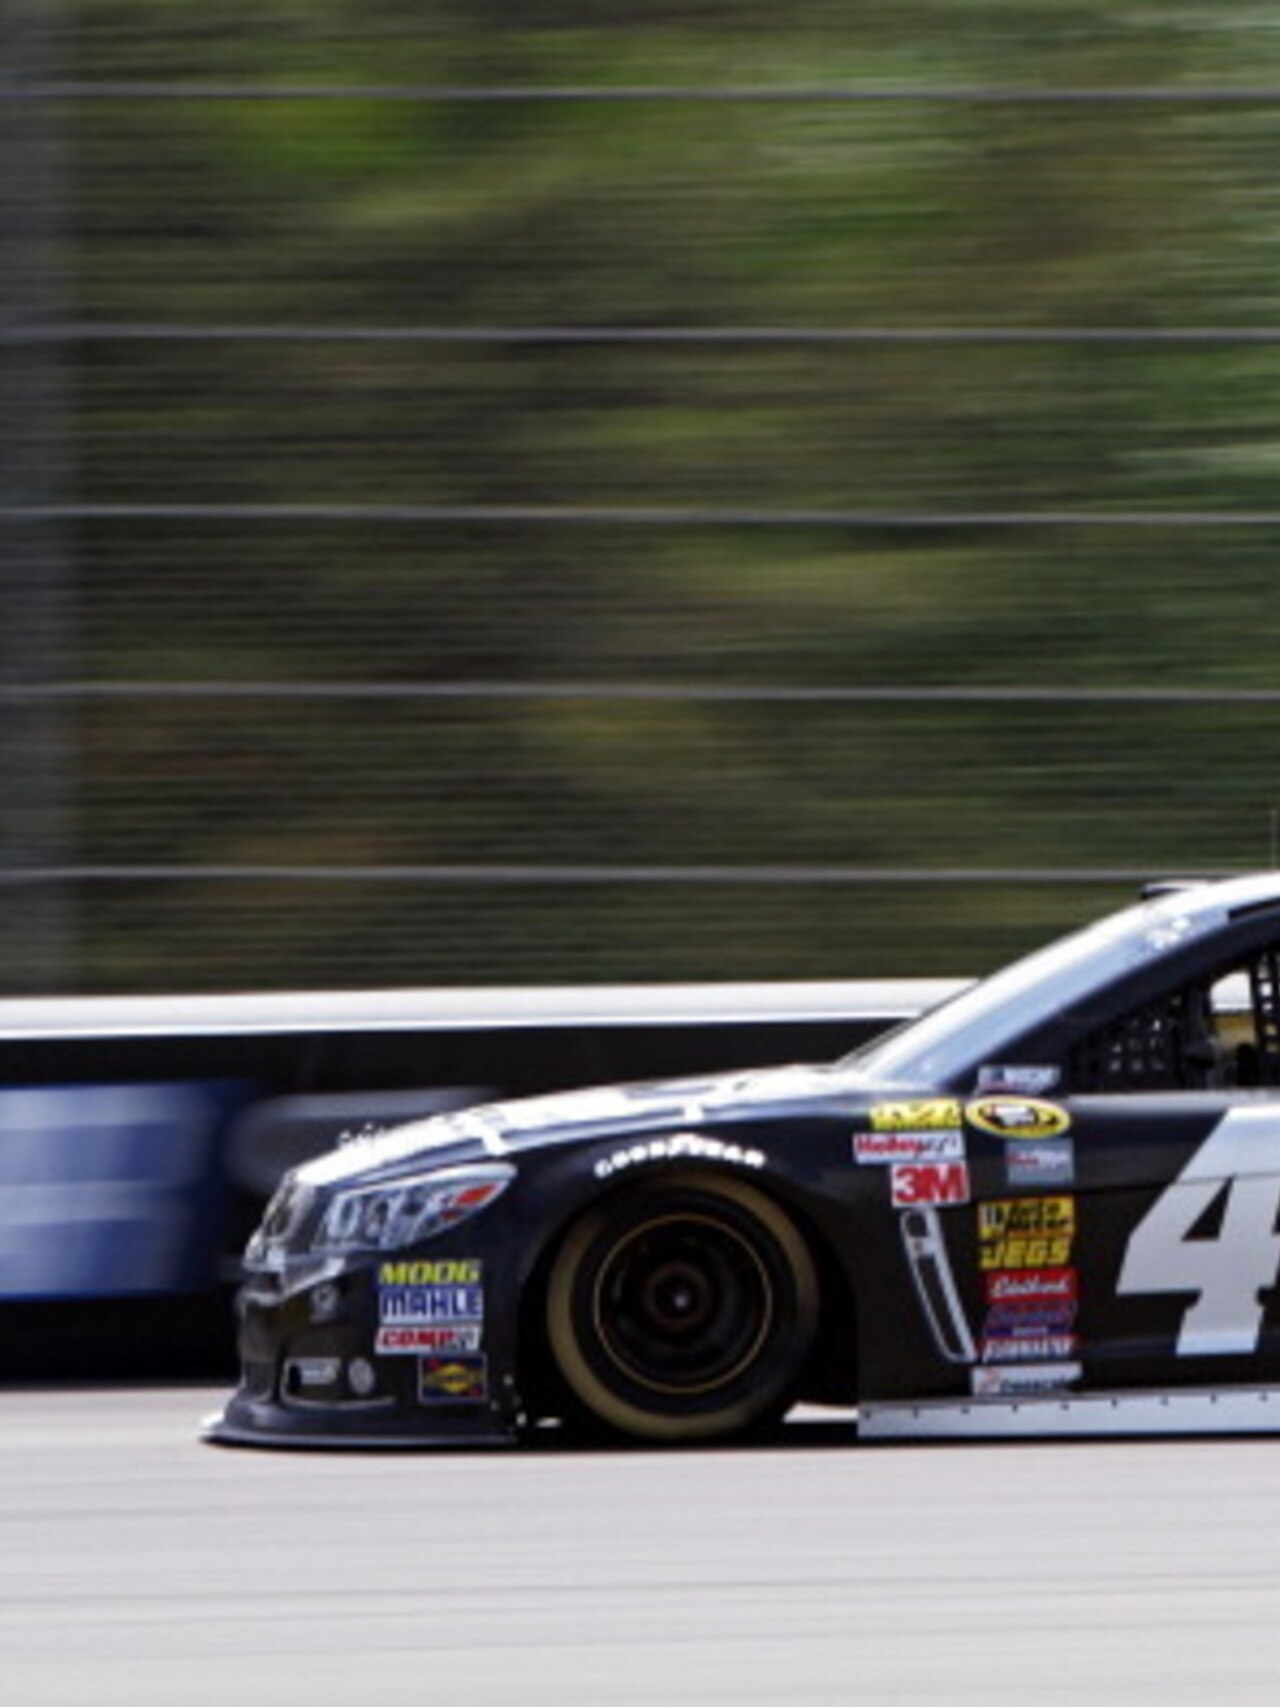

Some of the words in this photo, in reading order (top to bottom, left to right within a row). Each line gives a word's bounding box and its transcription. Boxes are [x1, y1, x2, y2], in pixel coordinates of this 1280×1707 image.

[593, 1132, 766, 1178] GOODYEAR
[895, 1165, 967, 1203] 3M
[981, 1238, 1069, 1269] JEGS
[379, 1260, 481, 1285] MOOG
[381, 1289, 482, 1317] MAHLE
